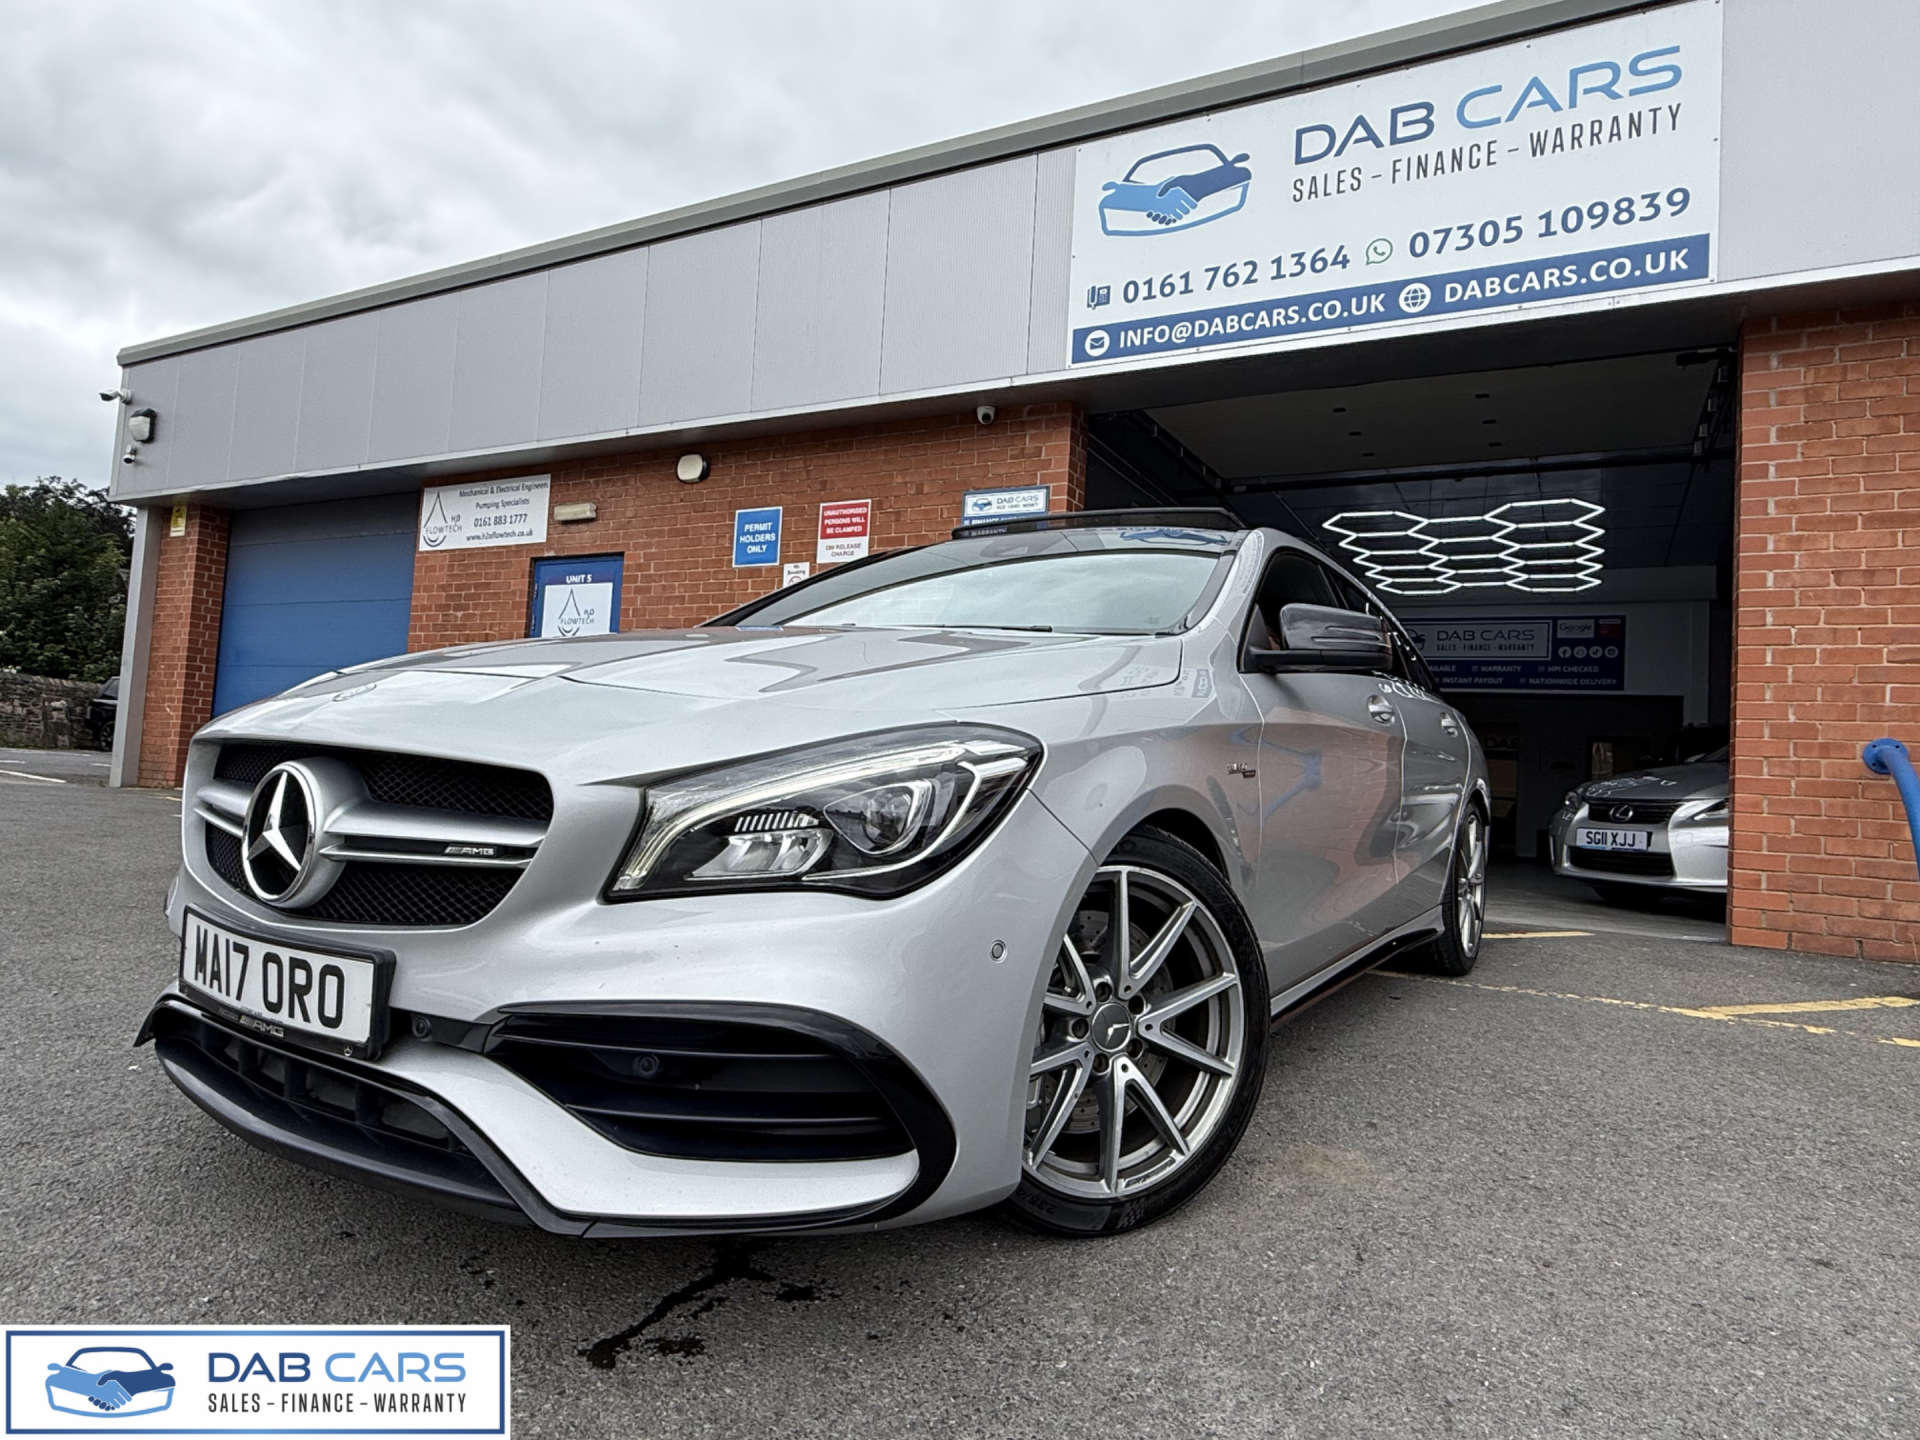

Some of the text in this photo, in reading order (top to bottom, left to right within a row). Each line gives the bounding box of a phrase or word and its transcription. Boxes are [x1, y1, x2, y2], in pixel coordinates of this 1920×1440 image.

[1294, 45, 1683, 165] DAB CARS
[1292, 166, 1364, 203] SALES
[1392, 140, 1499, 184] FINANCE
[1529, 103, 1682, 158] WARRANTY
[1409, 187, 1691, 259] 07305 109839
[1122, 245, 1351, 304] 0161 762 1364
[1444, 248, 1690, 303] DABCARS.CO.UK
[1119, 293, 1386, 349] INFO@DABCARS.CO.UK
[474, 516, 492, 527] 0161
[509, 513, 528, 525] 1777
[744, 522, 773, 533] PERMIT
[852, 516, 865, 524] WILL
[740, 533, 776, 544] HOLDERS
[746, 544, 768, 554] ONLY
[566, 574, 586, 584] UNIT
[1437, 629, 1535, 641] DAB CARS
[1610, 832, 1636, 847] XJJ
[194, 924, 345, 1029] MA17 ORO
[252, 1020, 284, 1038] AMG
